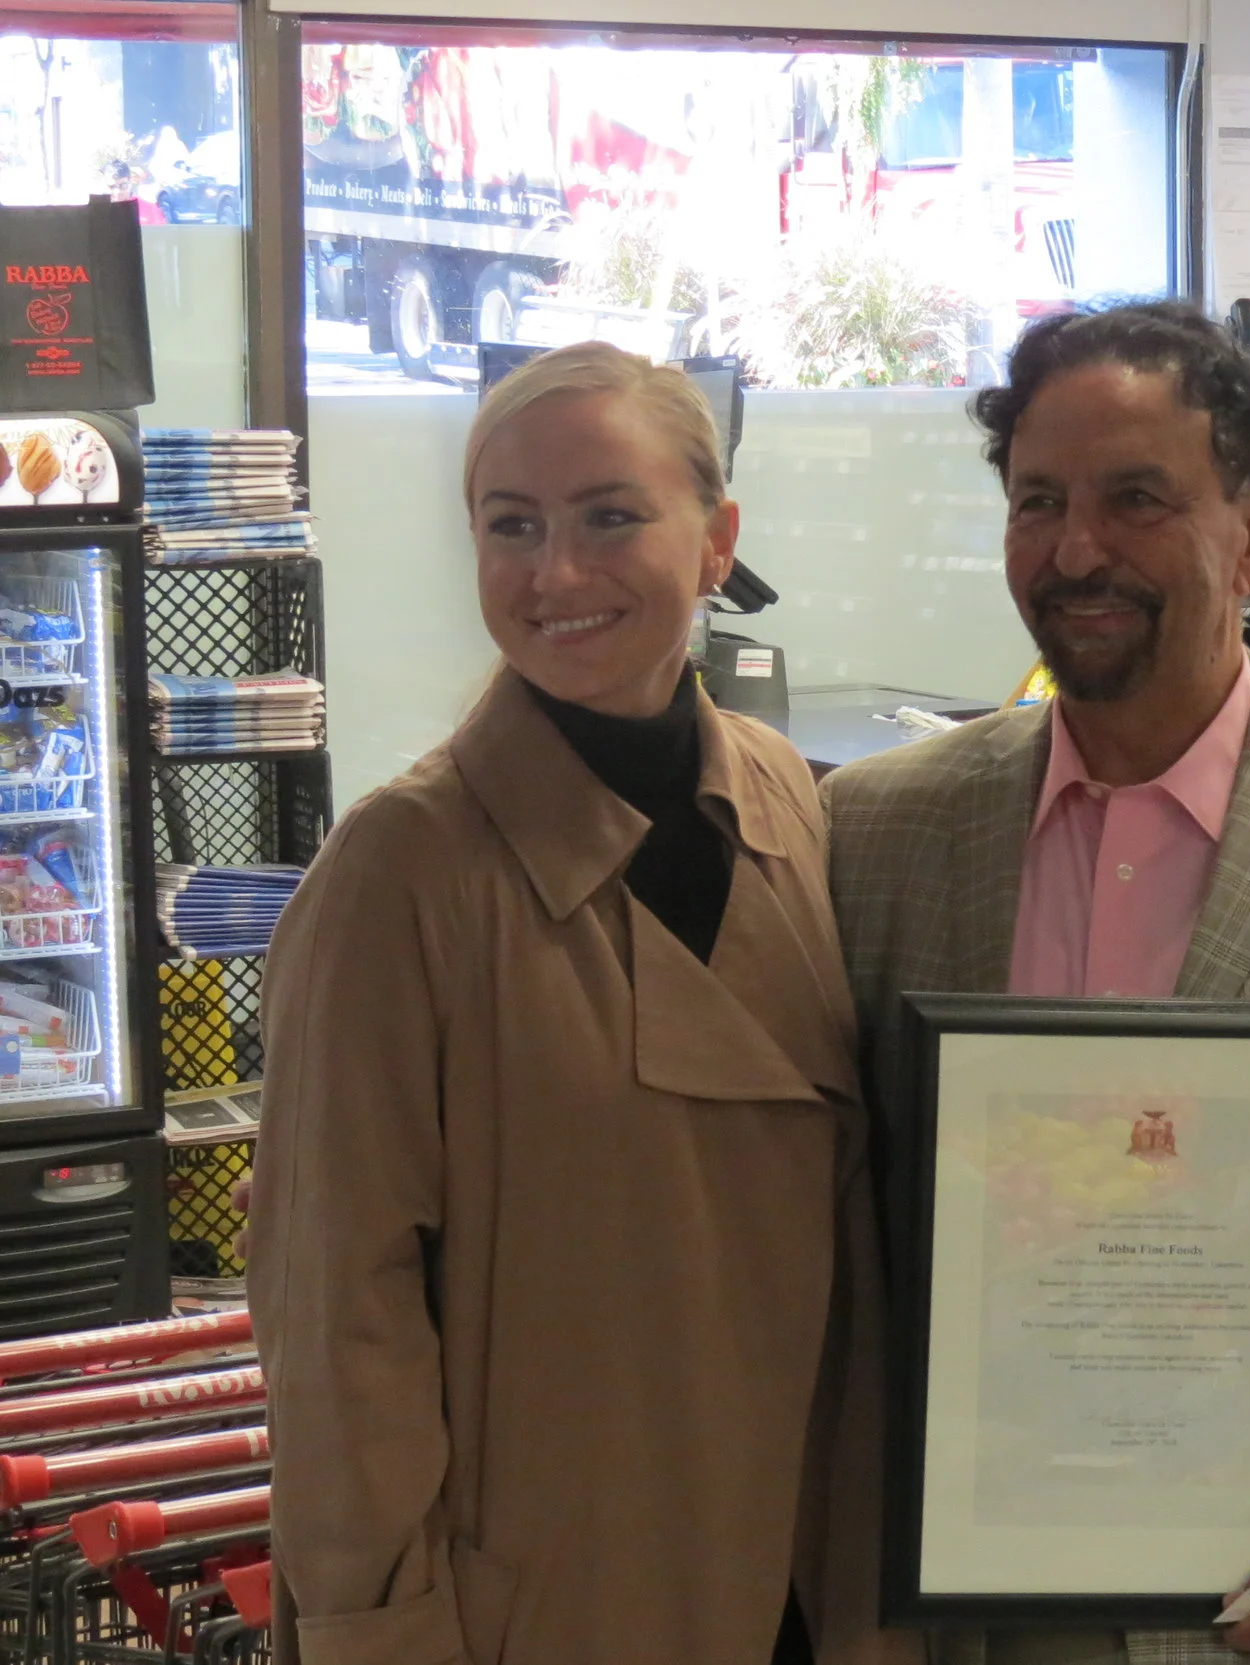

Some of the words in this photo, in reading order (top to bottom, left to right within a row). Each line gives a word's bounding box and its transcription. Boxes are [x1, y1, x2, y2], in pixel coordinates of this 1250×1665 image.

[306, 178, 337, 197] Produce
[345, 180, 374, 207] Bakery
[381, 184, 404, 203] Meats
[414, 187, 432, 206] Deli
[6, 265, 90, 283] RABBA
[1098, 1243, 1136, 1254] Rabba
[1140, 1244, 1164, 1255] Fine
[1168, 1245, 1203, 1256] Foods
